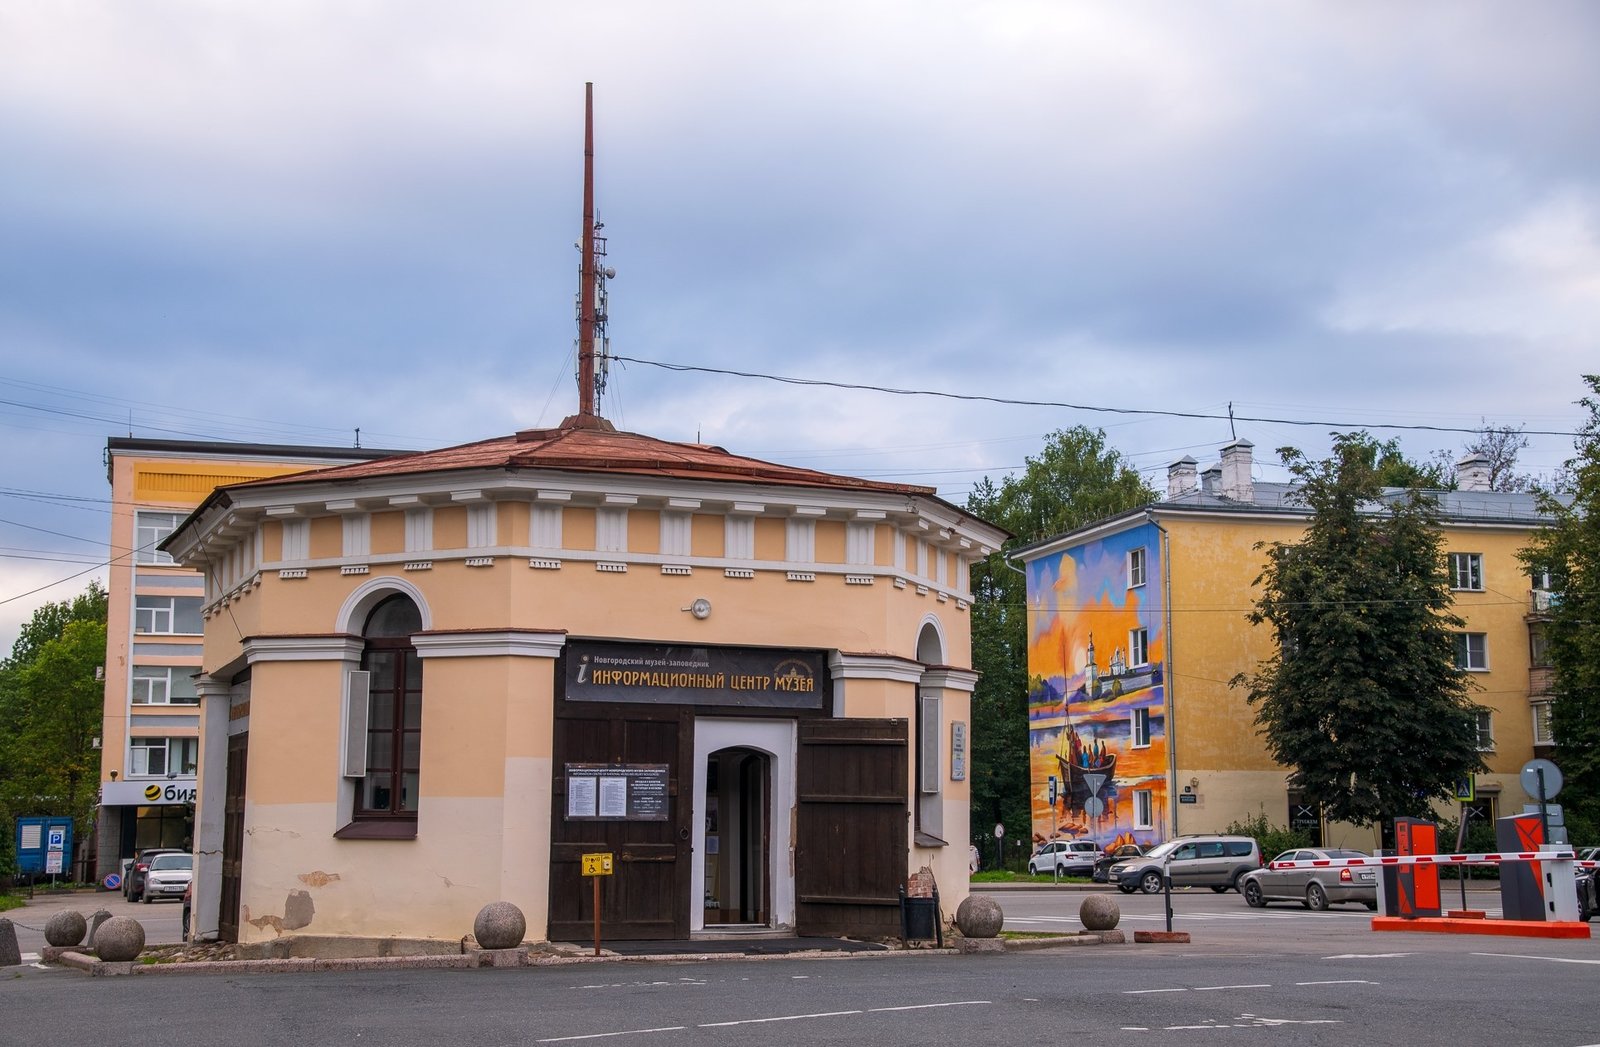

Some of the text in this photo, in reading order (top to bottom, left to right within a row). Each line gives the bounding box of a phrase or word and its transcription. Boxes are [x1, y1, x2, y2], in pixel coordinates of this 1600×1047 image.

[594, 656, 710, 668] Новгородский музей-заповедник
[592, 670, 814, 692] ИНФОРМАЦИОННЫЙ ЦЕНТР МУЗЕЯ
